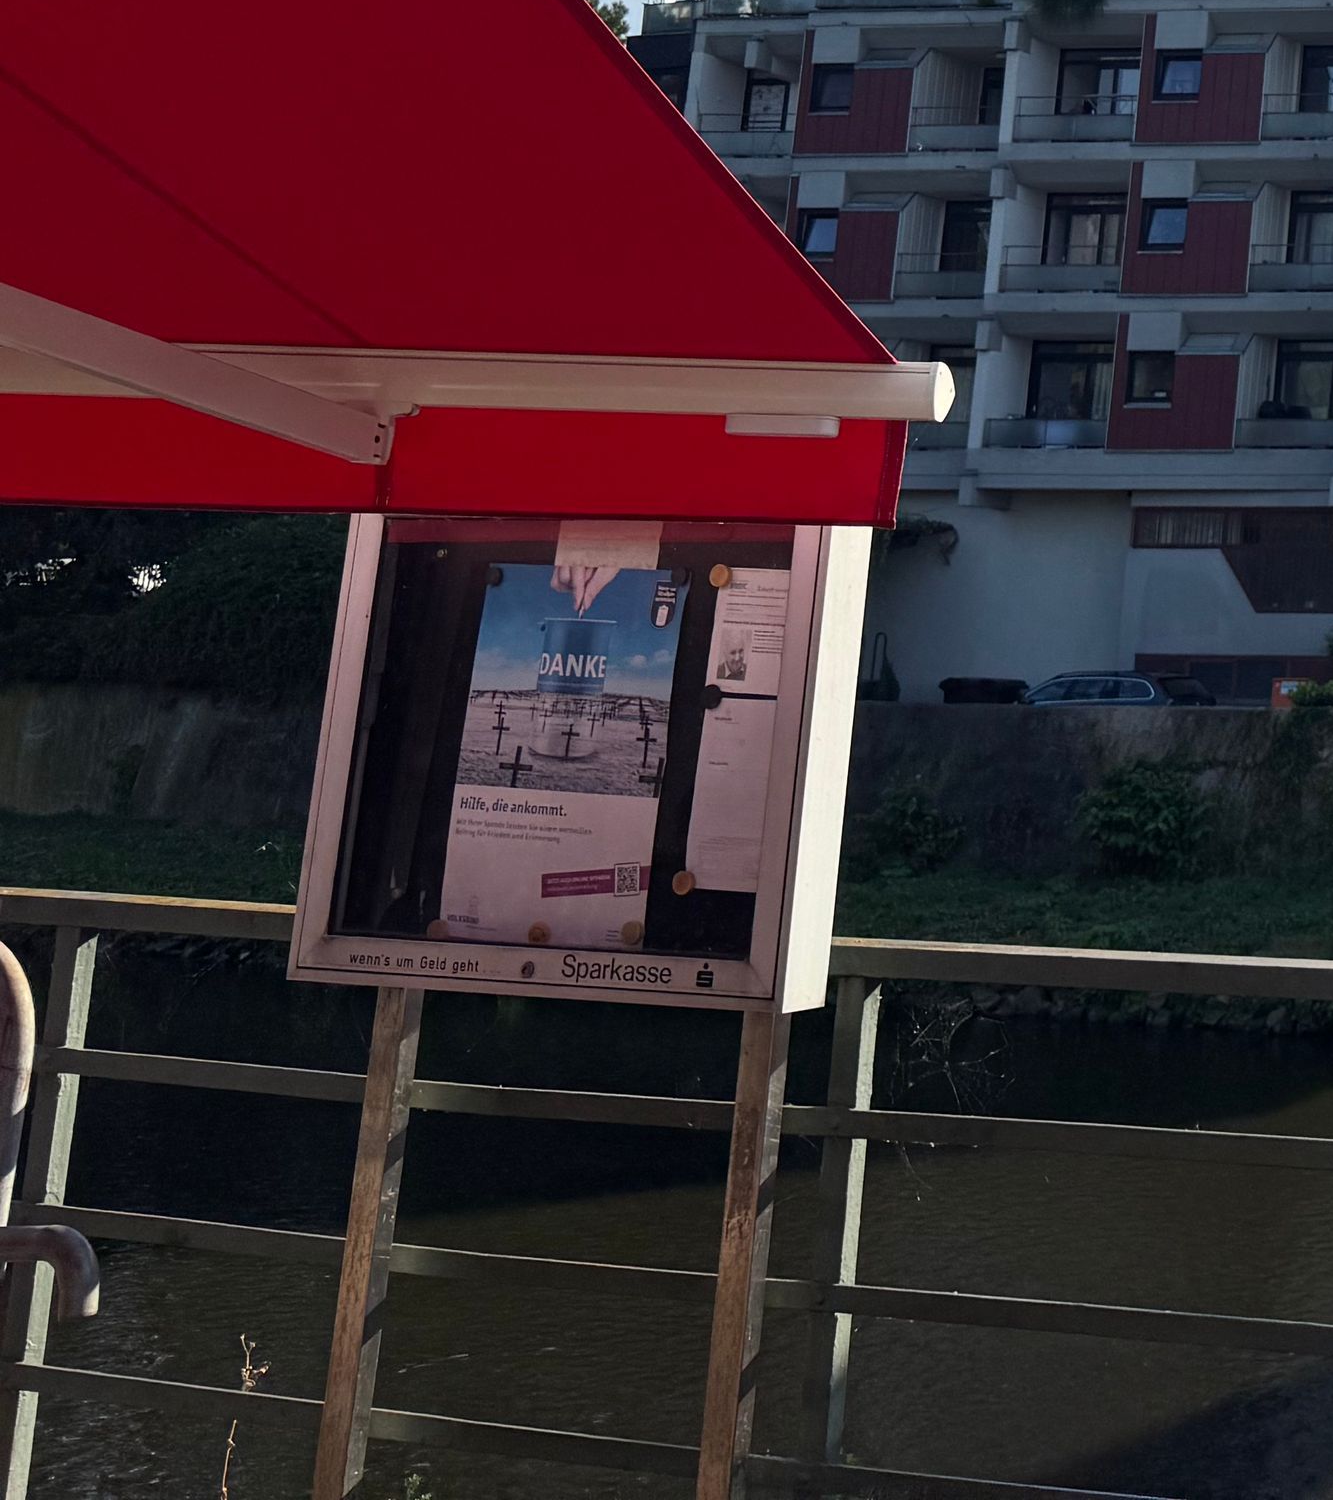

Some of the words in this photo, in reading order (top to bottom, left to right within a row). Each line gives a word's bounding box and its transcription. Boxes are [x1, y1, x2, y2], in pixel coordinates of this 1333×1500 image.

[540, 653, 607, 678] DANKE
[460, 797, 490, 812] Hilfe,
[492, 798, 509, 812] die
[510, 800, 567, 817] ankommt.
[349, 953, 391, 967] wenn's
[396, 957, 414, 969] um
[420, 956, 447, 970] Geld
[452, 959, 479, 974] geht
[561, 953, 672, 984] Sparkasse
